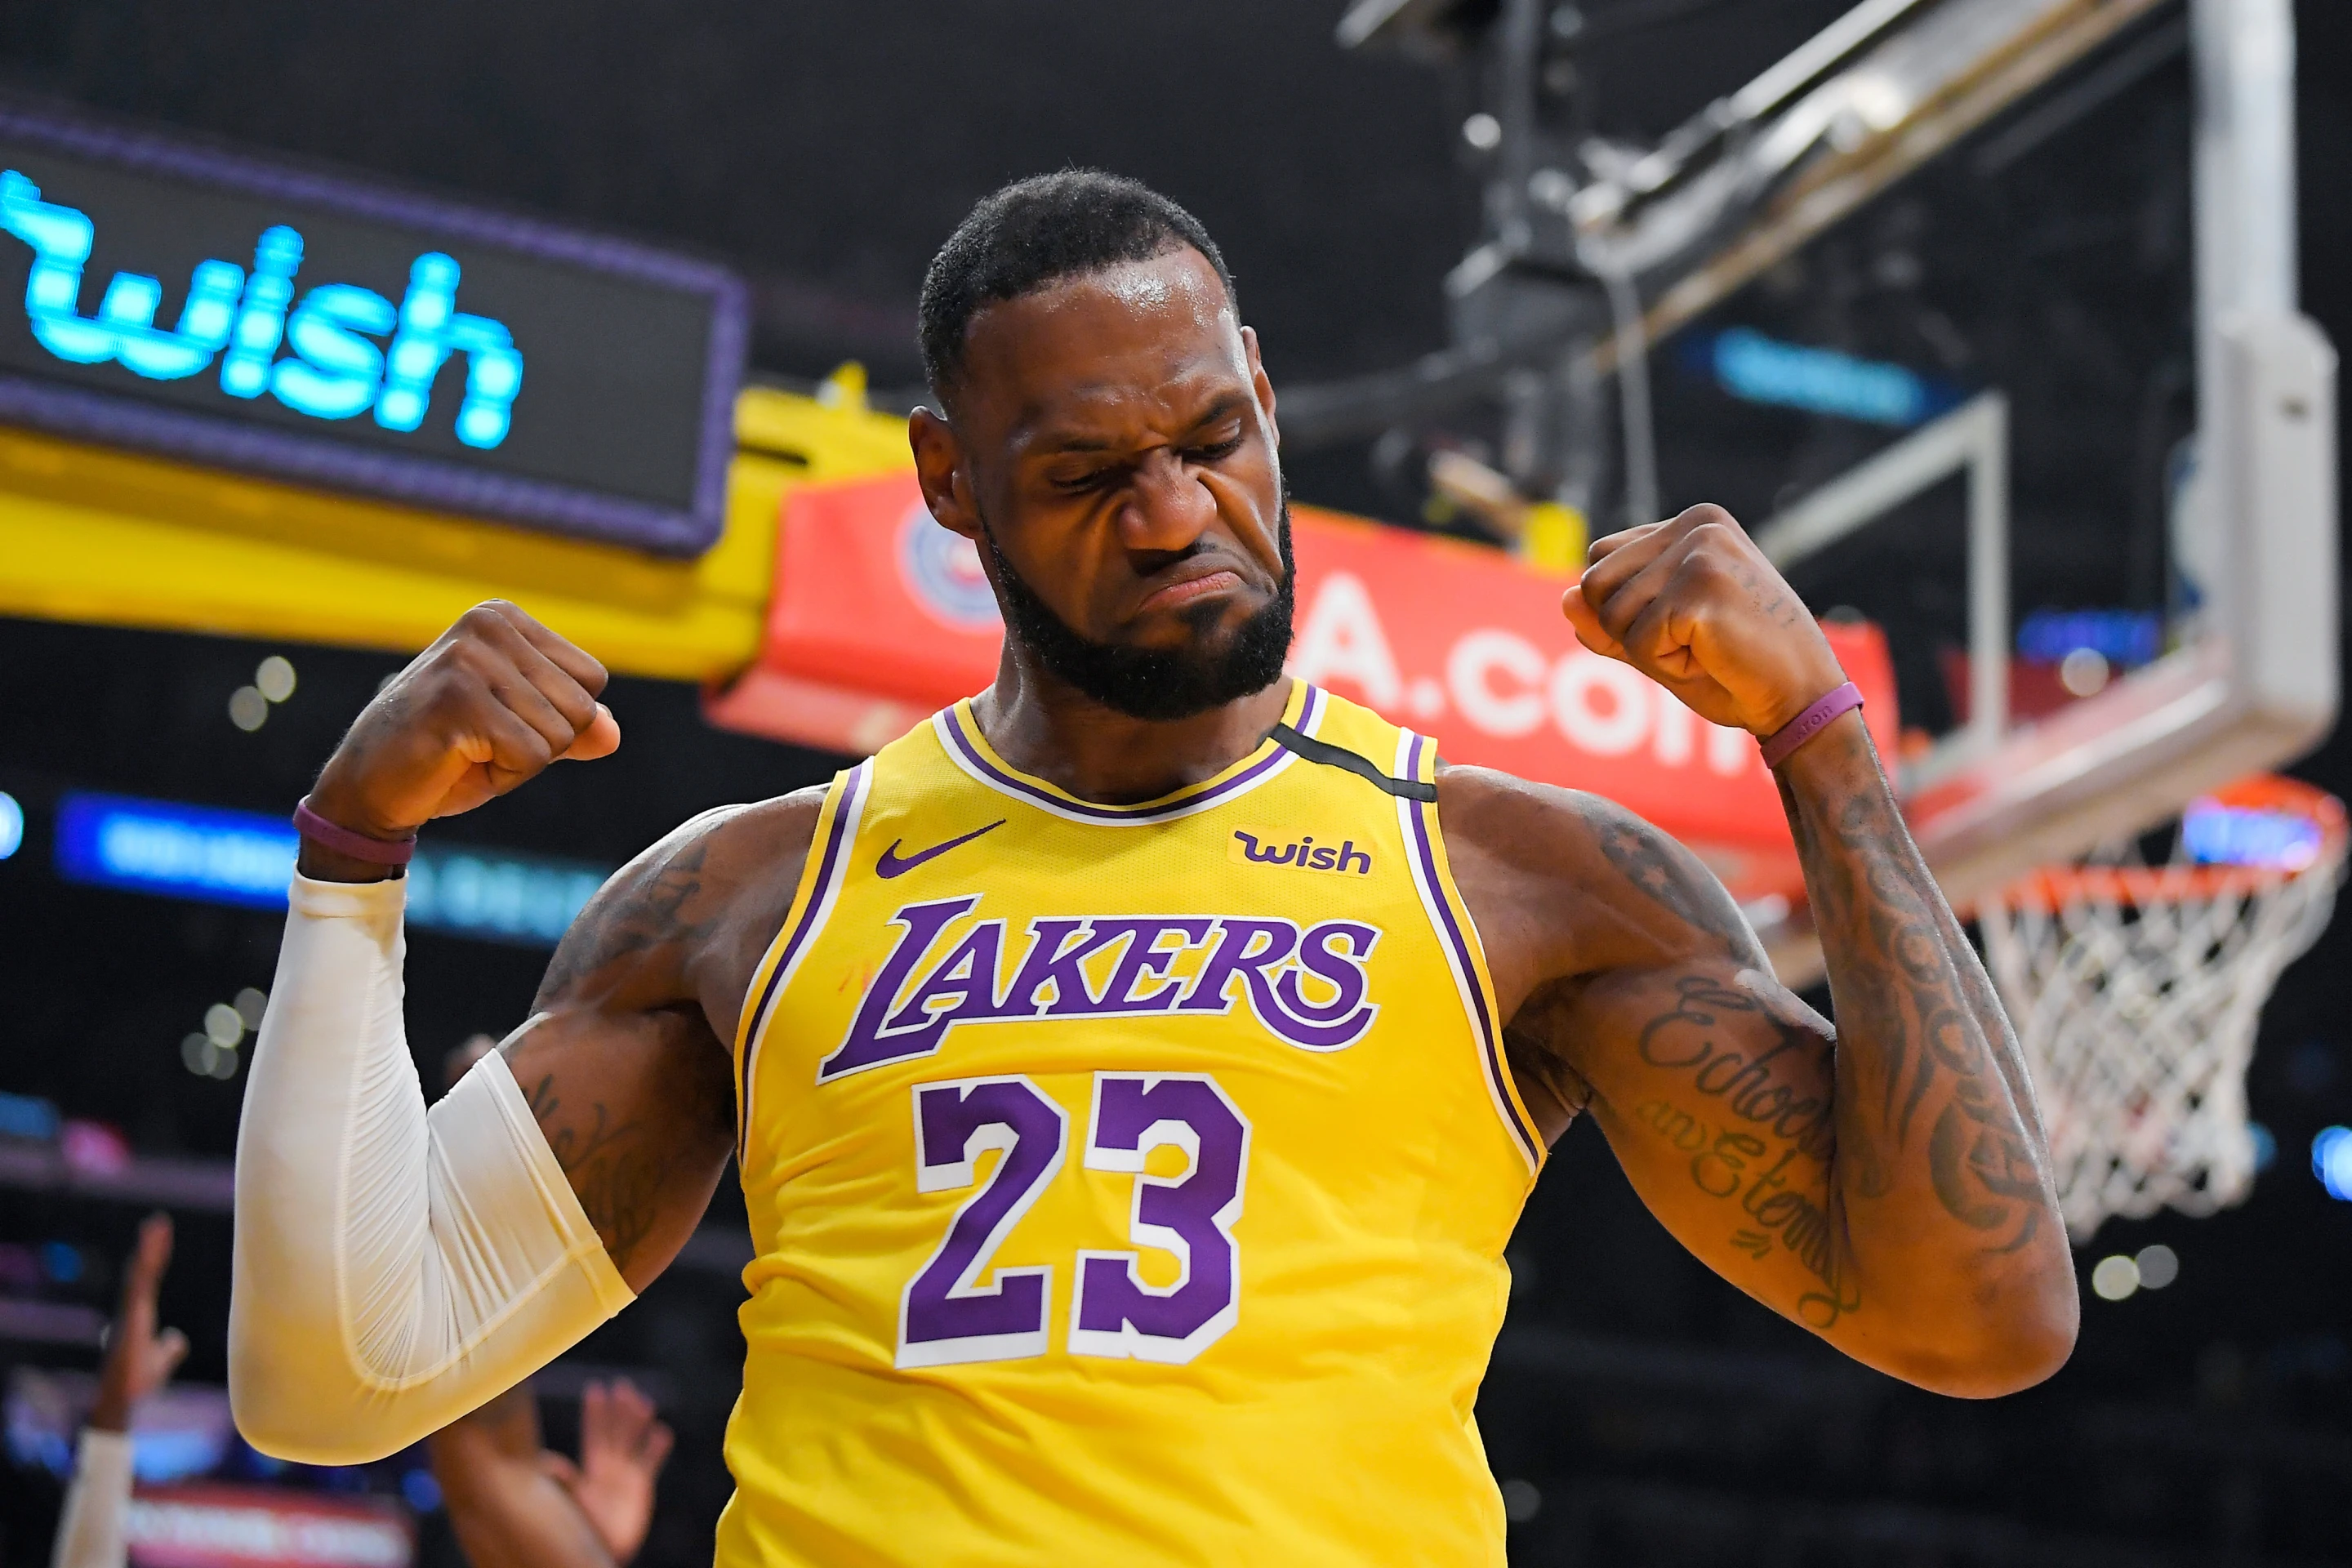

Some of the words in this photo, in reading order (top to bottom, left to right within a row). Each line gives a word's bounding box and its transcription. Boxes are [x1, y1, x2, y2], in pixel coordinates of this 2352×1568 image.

[0, 169, 524, 449] wish
[1234, 830, 1371, 875] wish
[817, 893, 1383, 1086] LAKERS
[894, 1071, 1251, 1370] 23
